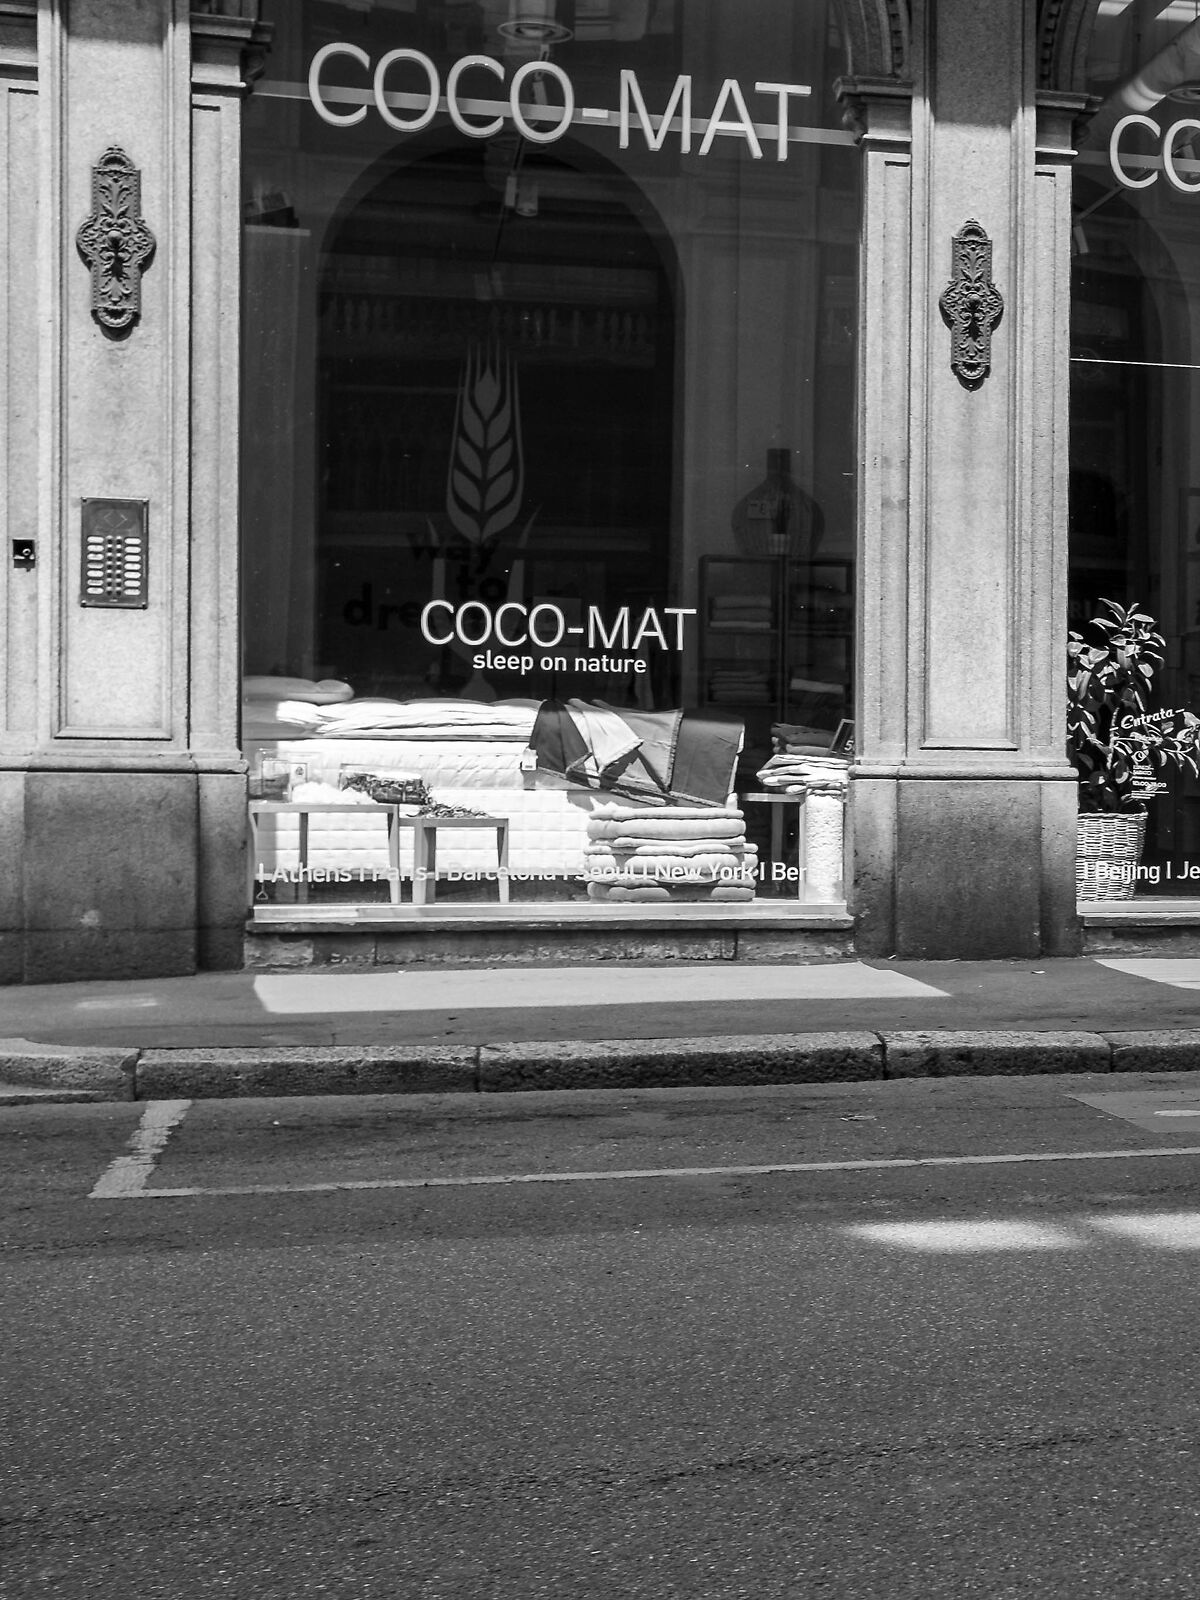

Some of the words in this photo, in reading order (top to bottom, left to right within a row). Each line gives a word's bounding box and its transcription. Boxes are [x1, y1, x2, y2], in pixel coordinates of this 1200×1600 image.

[308, 42, 812, 162] COCO-MAT
[420, 599, 697, 651] COCO-MAT
[472, 650, 533, 676] sleep
[540, 656, 567, 672] on
[574, 655, 647, 673] nature
[1121, 708, 1176, 729] Entrata
[271, 863, 352, 883] Athens
[655, 863, 702, 882] New
[708, 862, 755, 882] York
[1096, 861, 1161, 884] Beijing
